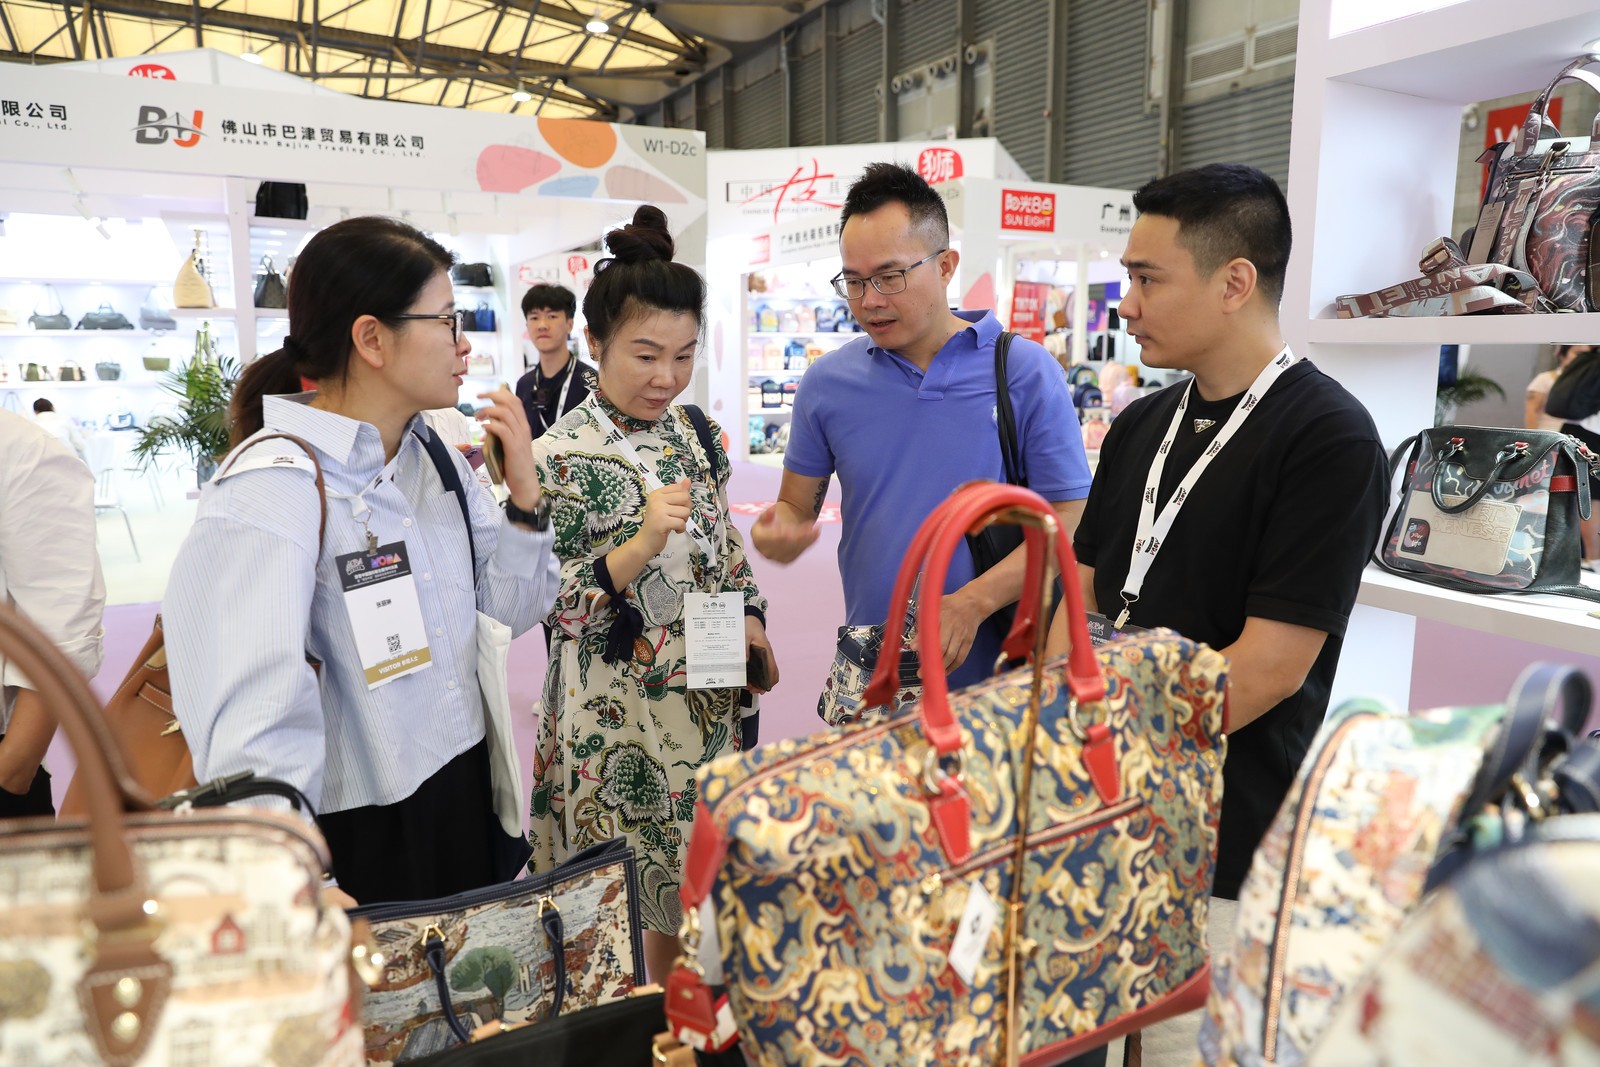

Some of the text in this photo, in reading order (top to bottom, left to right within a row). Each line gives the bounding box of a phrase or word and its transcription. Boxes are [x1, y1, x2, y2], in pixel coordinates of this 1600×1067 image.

[14, 119, 40, 130] Co.,
[47, 122, 72, 131] Ltd.
[221, 119, 424, 150] 佛山市巴津贸易有限公司
[643, 138, 698, 157] W1-D2c
[1005, 213, 1053, 228] SUN EIGHT
[1101, 202, 1140, 222] 广州
[1410, 278, 1462, 301] JANET
[378, 661, 402, 675] VISITOR
